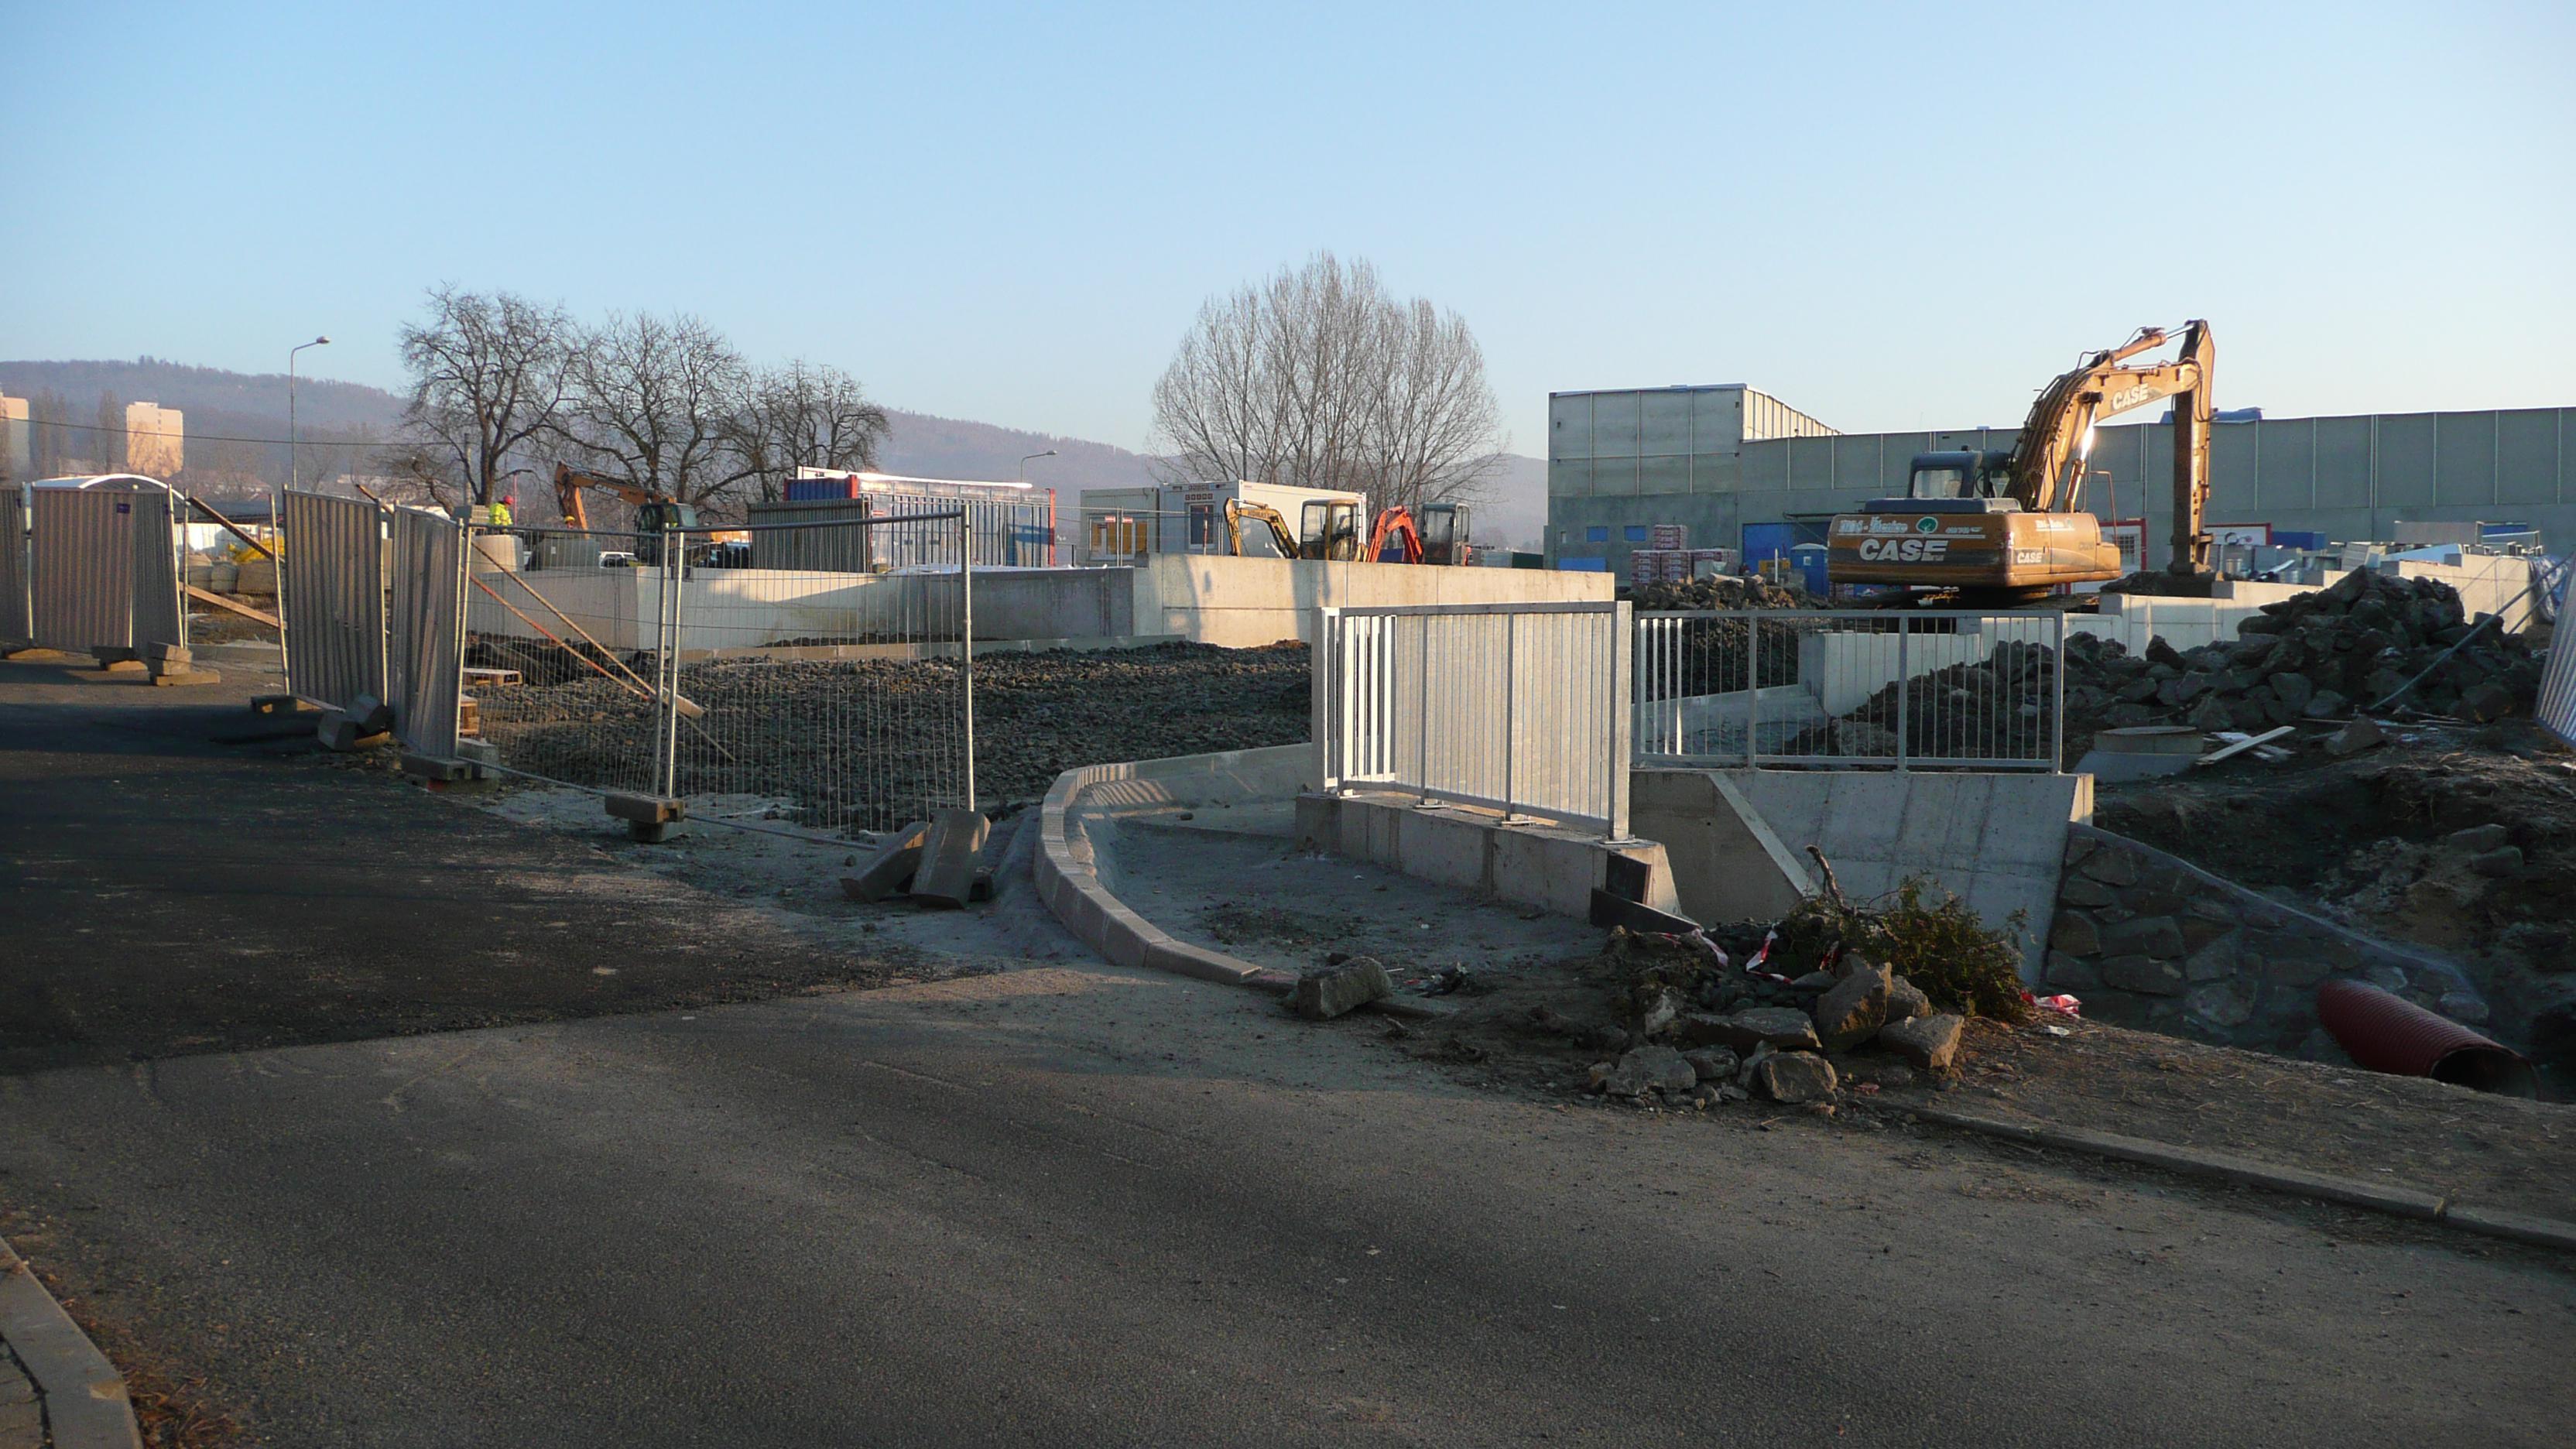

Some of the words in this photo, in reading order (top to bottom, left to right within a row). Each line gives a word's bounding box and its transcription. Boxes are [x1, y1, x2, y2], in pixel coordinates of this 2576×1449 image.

[2112, 382, 2149, 410] CASE
[1859, 538, 1949, 561] CASE
[2017, 552, 2043, 564] CASE
